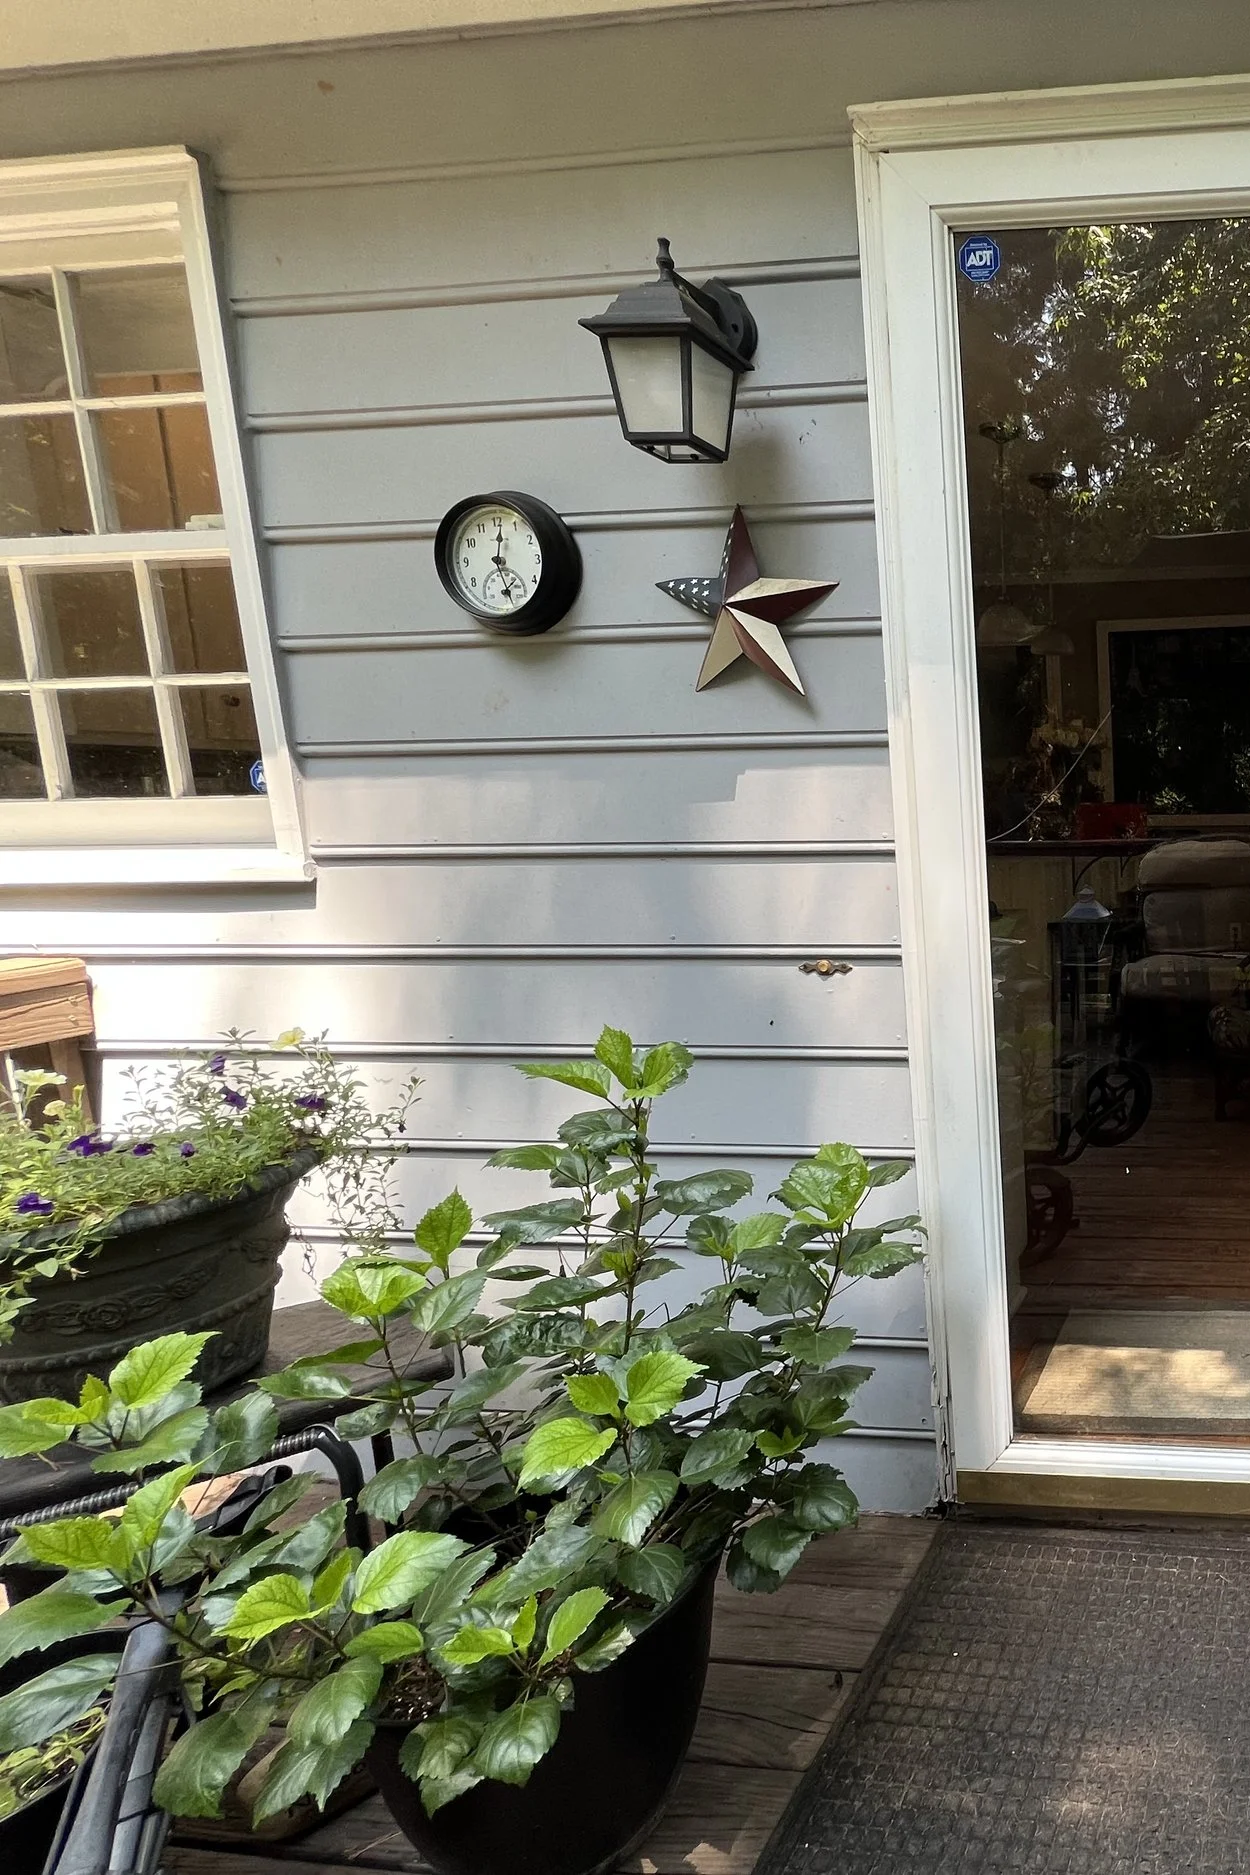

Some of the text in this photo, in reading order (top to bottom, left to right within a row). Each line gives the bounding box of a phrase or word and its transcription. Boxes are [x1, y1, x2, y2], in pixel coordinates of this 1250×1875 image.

[967, 250, 993, 267] ADT
[491, 516, 503, 527] 12
[512, 521, 518, 531] 1
[477, 523, 486, 534] 11
[466, 537, 476, 548] 10
[526, 534, 533, 545] 2
[463, 557, 469, 568] 9
[534, 554, 541, 565] 3
[470, 577, 477, 587] 8
[531, 574, 538, 585] 4
